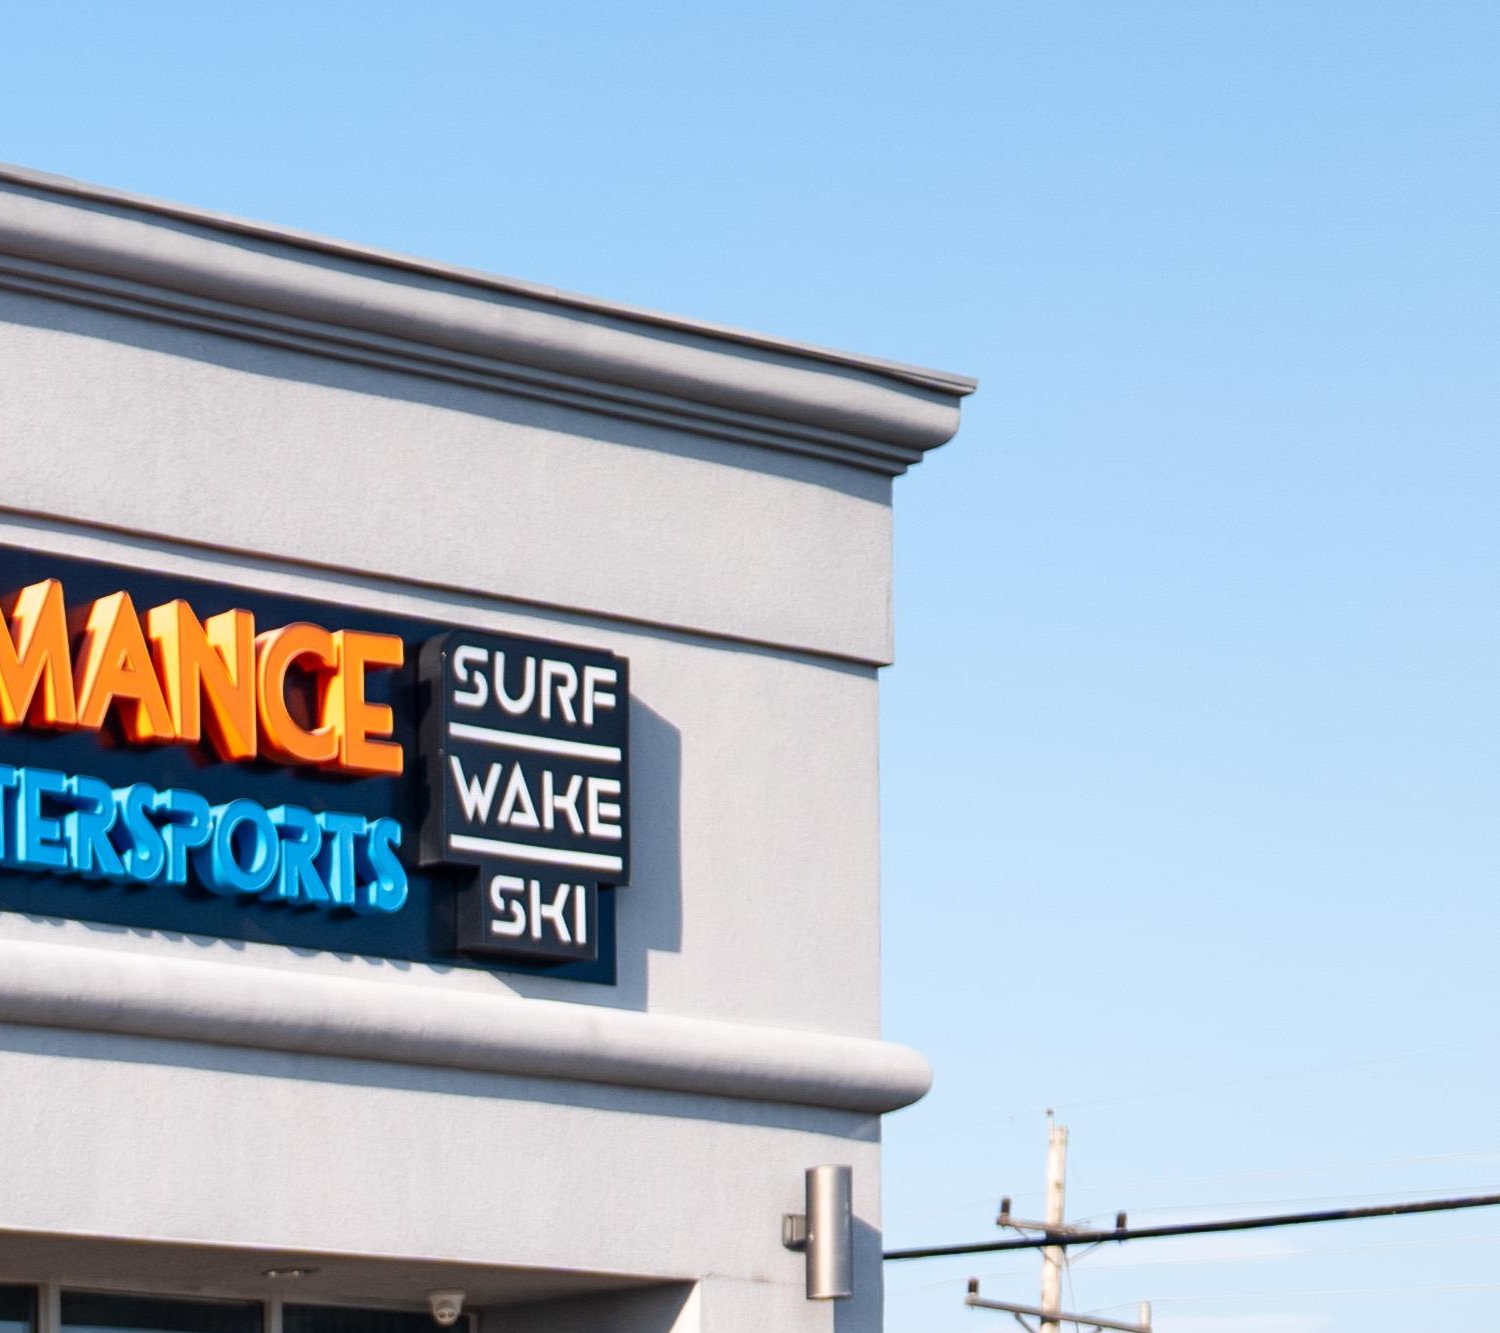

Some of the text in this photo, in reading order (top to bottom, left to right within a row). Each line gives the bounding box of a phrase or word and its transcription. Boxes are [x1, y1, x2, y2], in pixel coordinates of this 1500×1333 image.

[449, 644, 618, 727] SURF
[449, 753, 622, 839] WAKE
[489, 874, 588, 946] SKI
